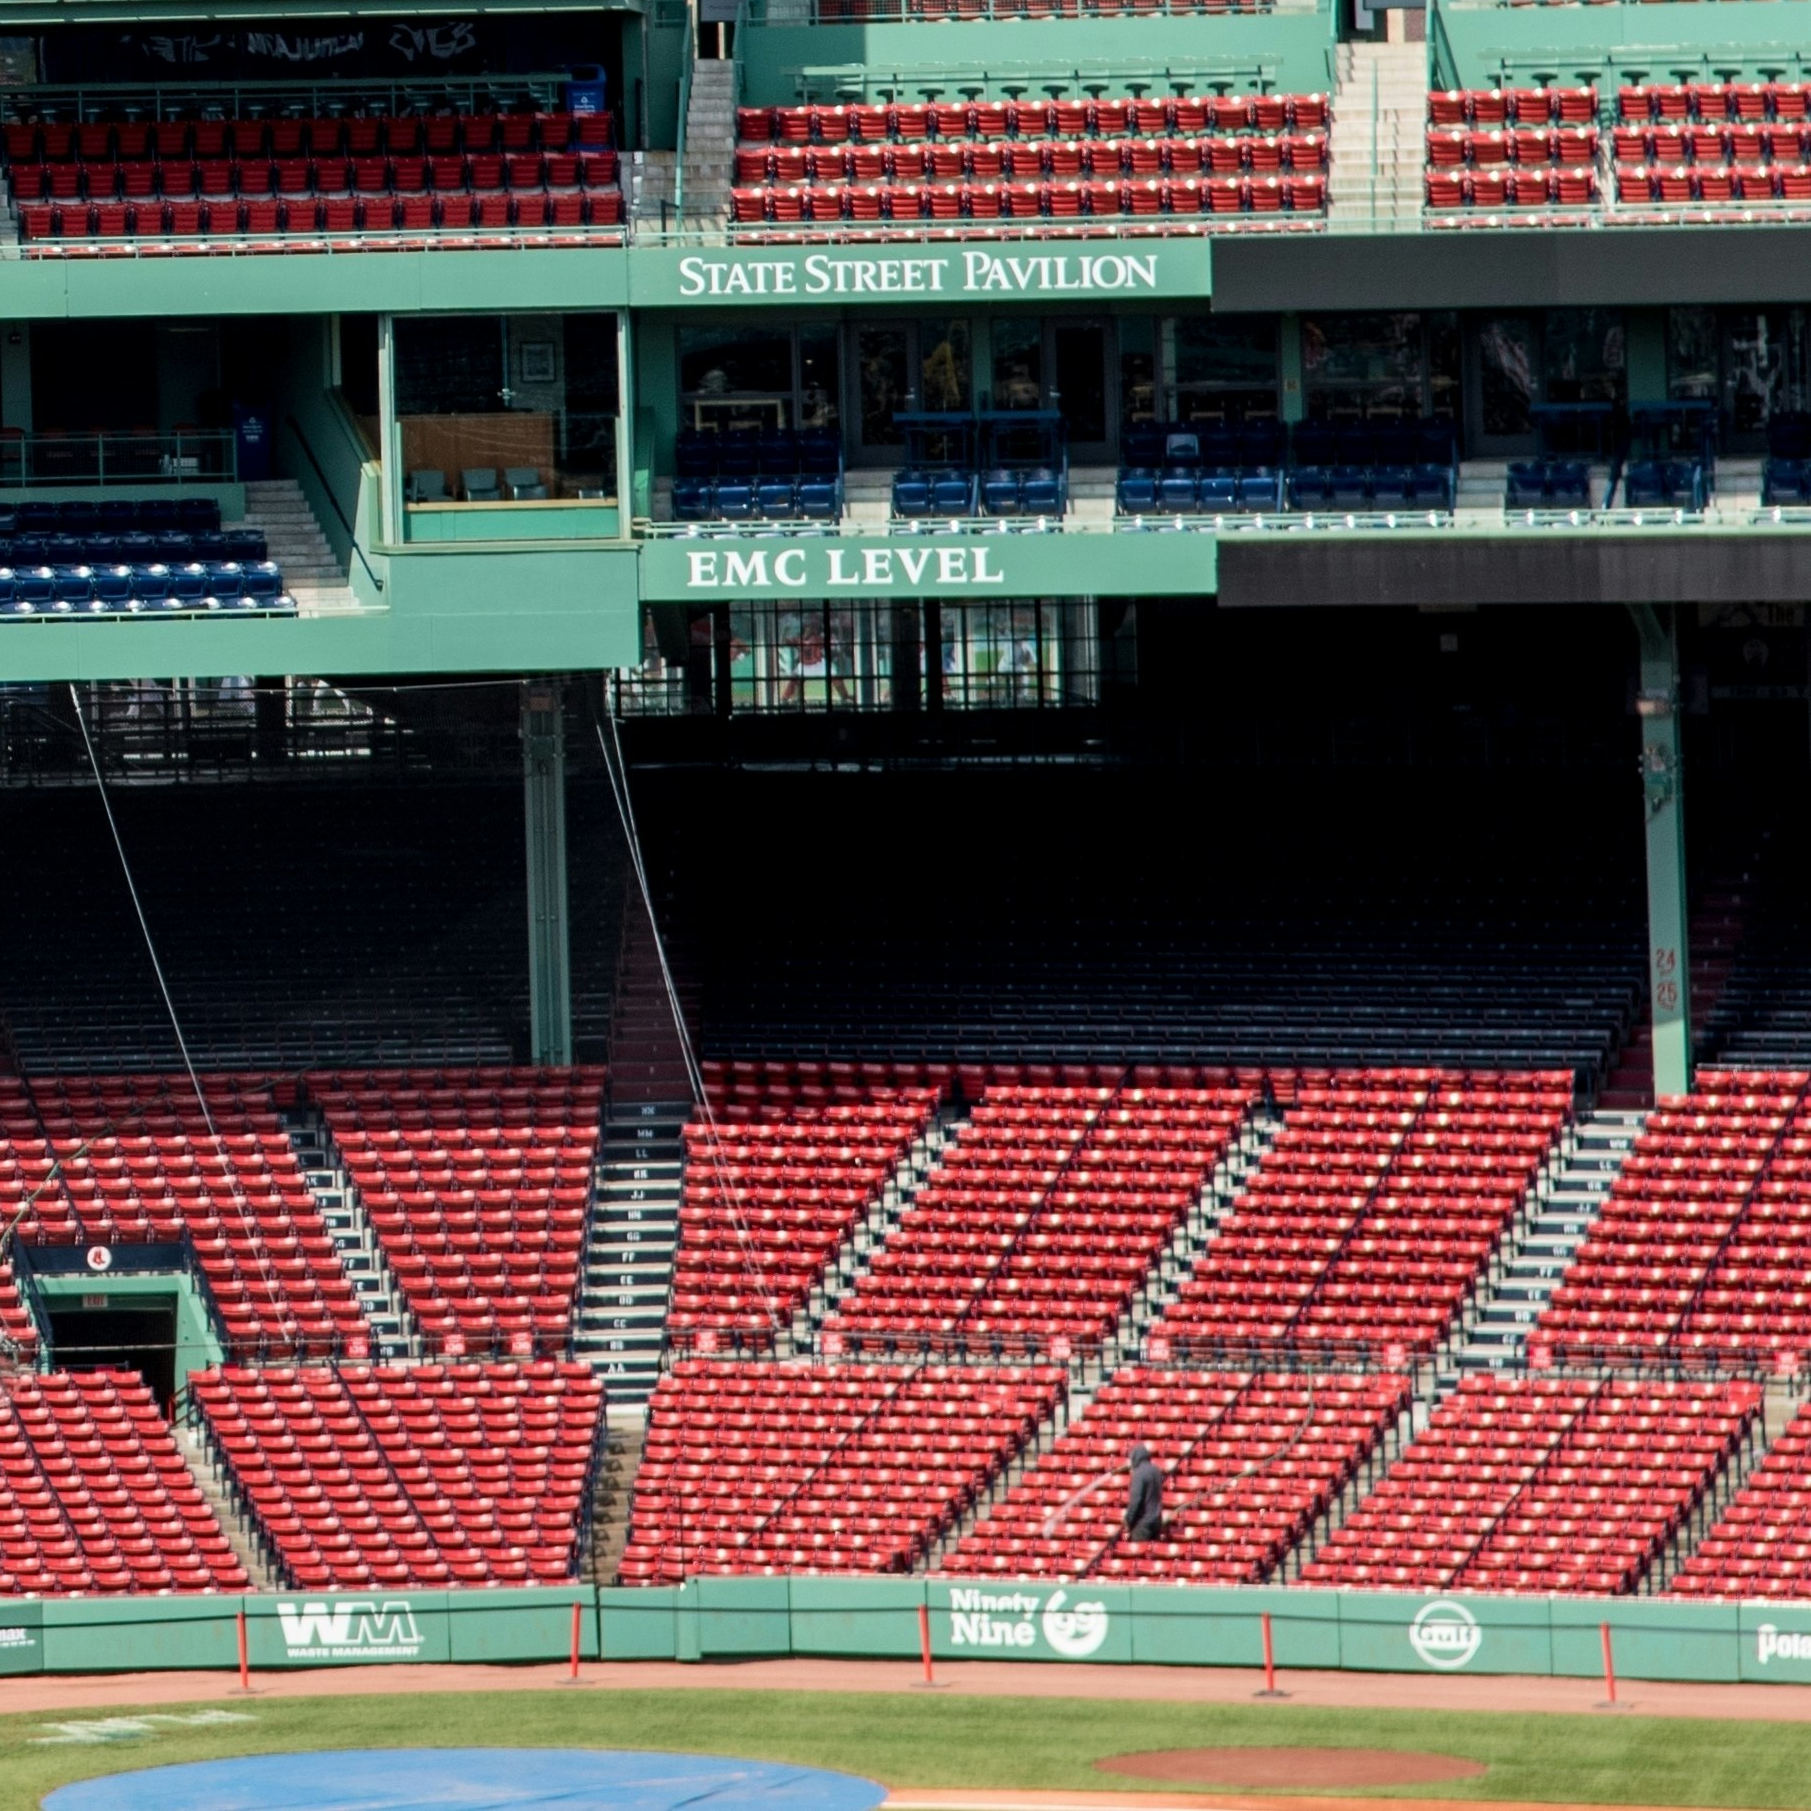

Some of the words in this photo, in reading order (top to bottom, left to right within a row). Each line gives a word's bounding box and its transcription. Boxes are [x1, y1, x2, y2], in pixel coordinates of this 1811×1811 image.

[679, 257, 797, 296] STATE
[804, 254, 949, 294] STREET
[962, 250, 1159, 291] PAVILION
[687, 548, 807, 587] EMC
[826, 546, 1005, 585] LEVEL
[636, 1149, 648, 1158] LL
[631, 1190, 644, 1200] JJ
[622, 1252, 635, 1263] FF
[608, 1363, 625, 1373] AA
[949, 1588, 1040, 1620] Ninety
[276, 1601, 419, 1645] WM
[950, 1612, 1037, 1647] Nine
[287, 1647, 330, 1658] WASTE
[332, 1646, 420, 1657] MANAGEMENT
